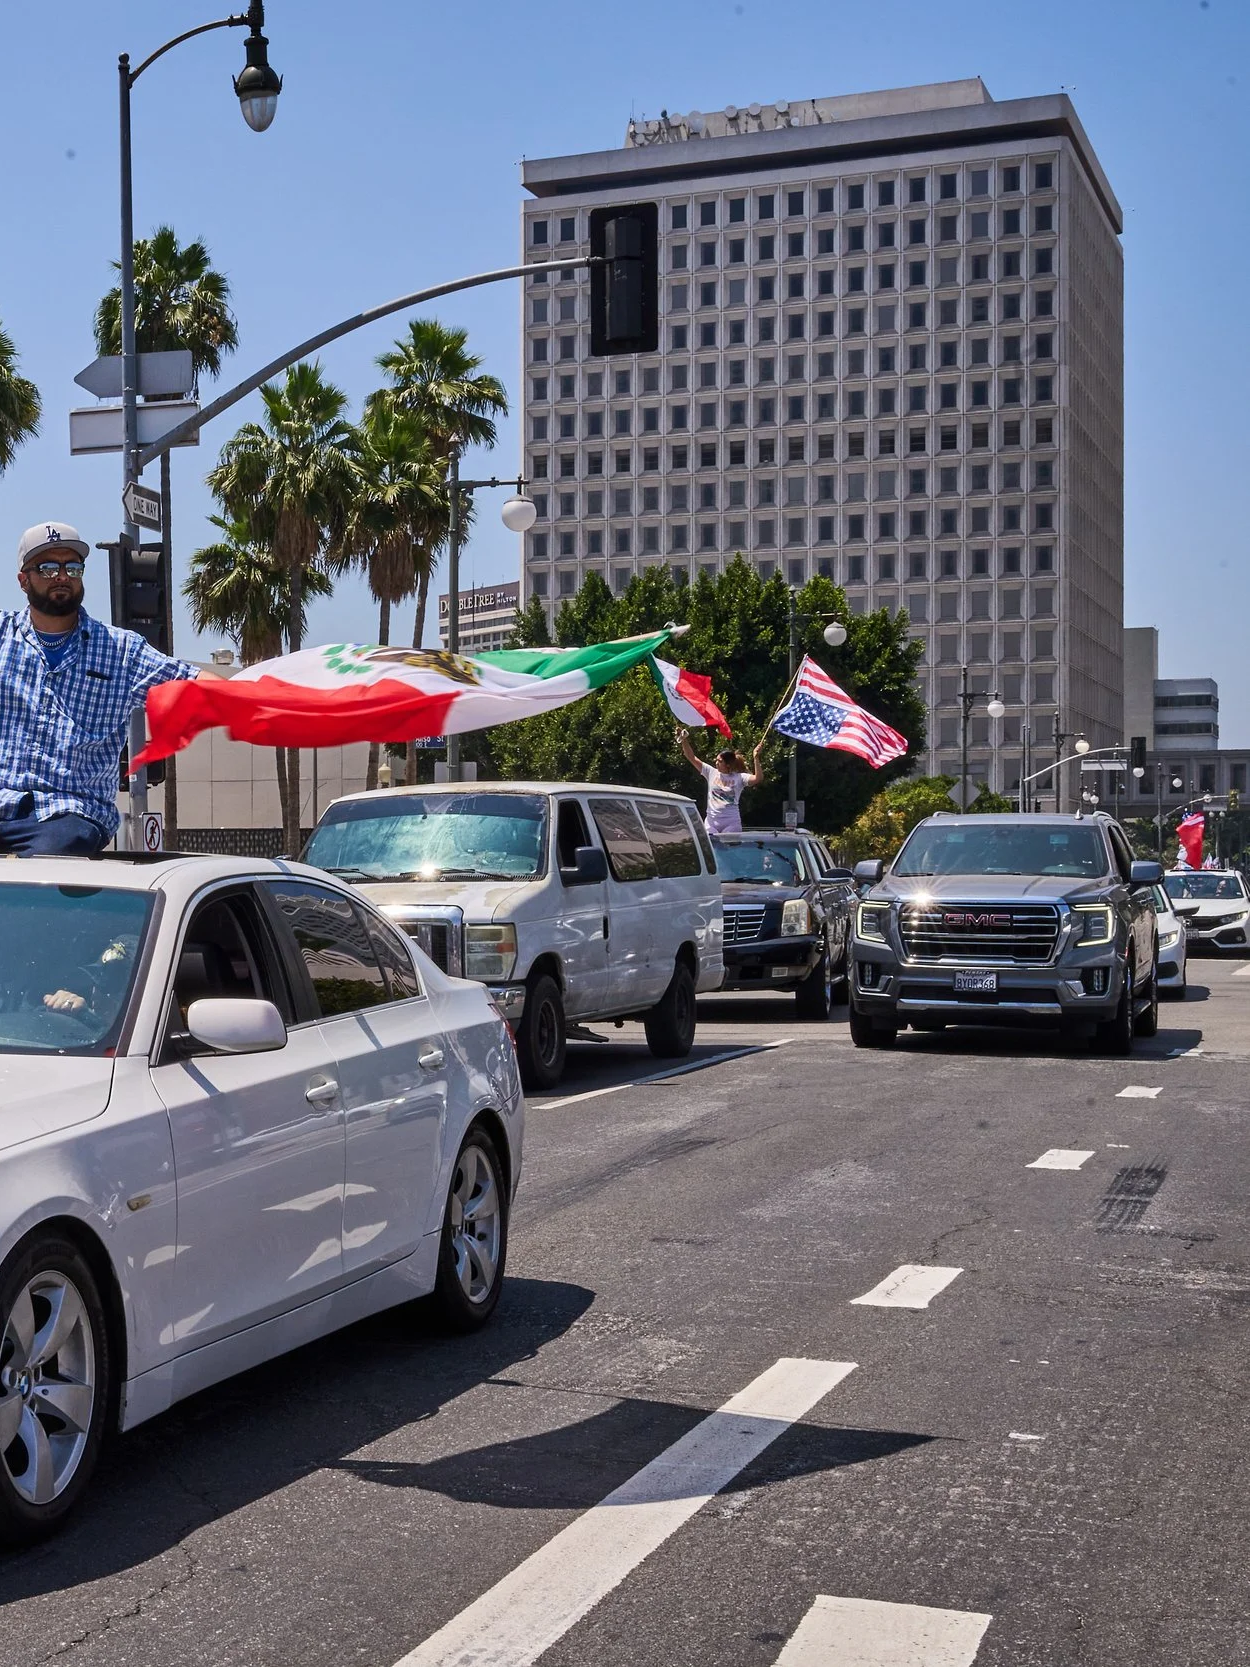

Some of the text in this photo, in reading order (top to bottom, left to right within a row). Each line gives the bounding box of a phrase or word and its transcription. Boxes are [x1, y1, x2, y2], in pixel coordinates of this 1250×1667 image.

[133, 496, 157, 518] ONE WAY
[440, 594, 495, 614] DBLETREE
[496, 596, 517, 604] HILTON
[943, 913, 1011, 926] GMC
